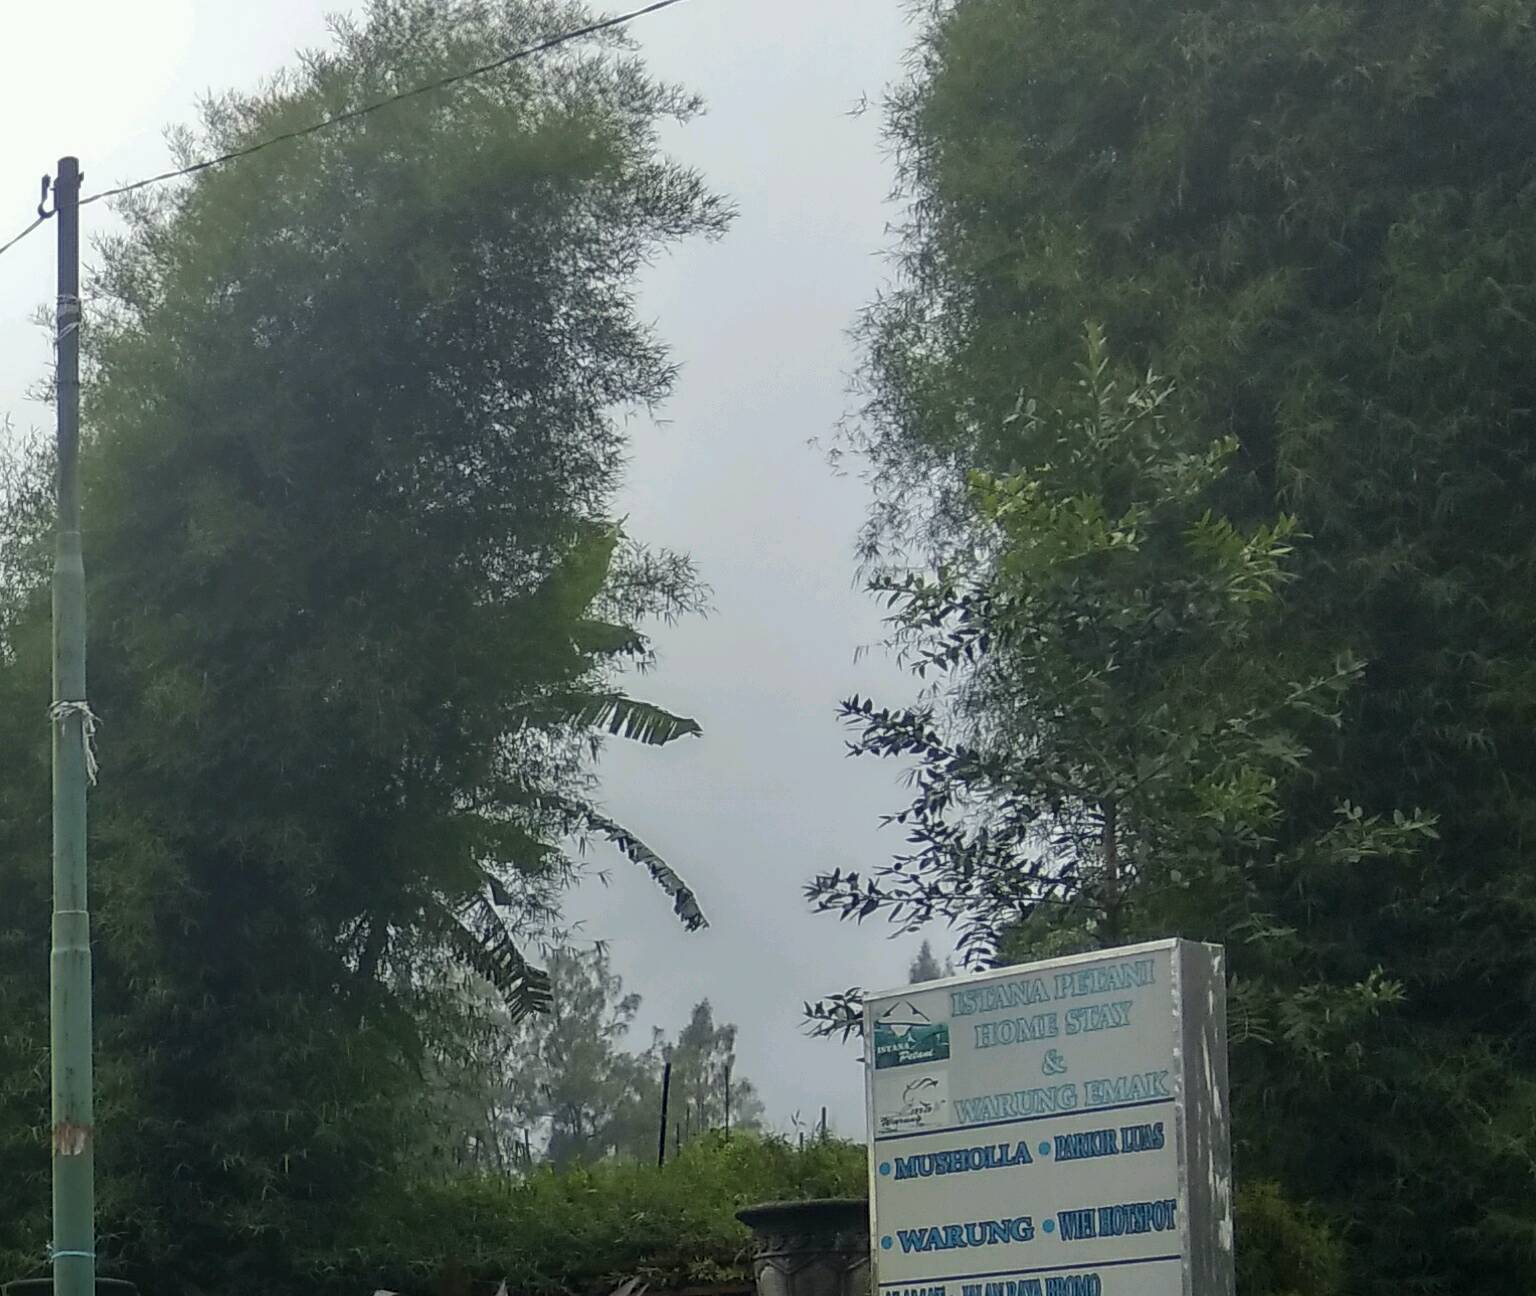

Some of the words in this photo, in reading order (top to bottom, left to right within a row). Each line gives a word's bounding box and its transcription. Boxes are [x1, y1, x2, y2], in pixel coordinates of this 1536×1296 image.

[951, 978, 1050, 1017] ISTANA
[1055, 959, 1155, 997] PETANI
[975, 1014, 1058, 1048] HOME
[1066, 1001, 1133, 1034] STAY
[1041, 1049, 1067, 1075] &
[953, 1083, 1077, 1124] WARUNG
[1084, 1071, 1169, 1107] EMAK
[894, 1141, 1033, 1180] MUSHOLLA
[1054, 1129, 1118, 1161] PARKIR
[1121, 1122, 1165, 1153] LUAS
[897, 1217, 1034, 1253] WARUNG
[1057, 1209, 1097, 1241] WIFI
[1098, 1199, 1177, 1237] HOTSPOT
